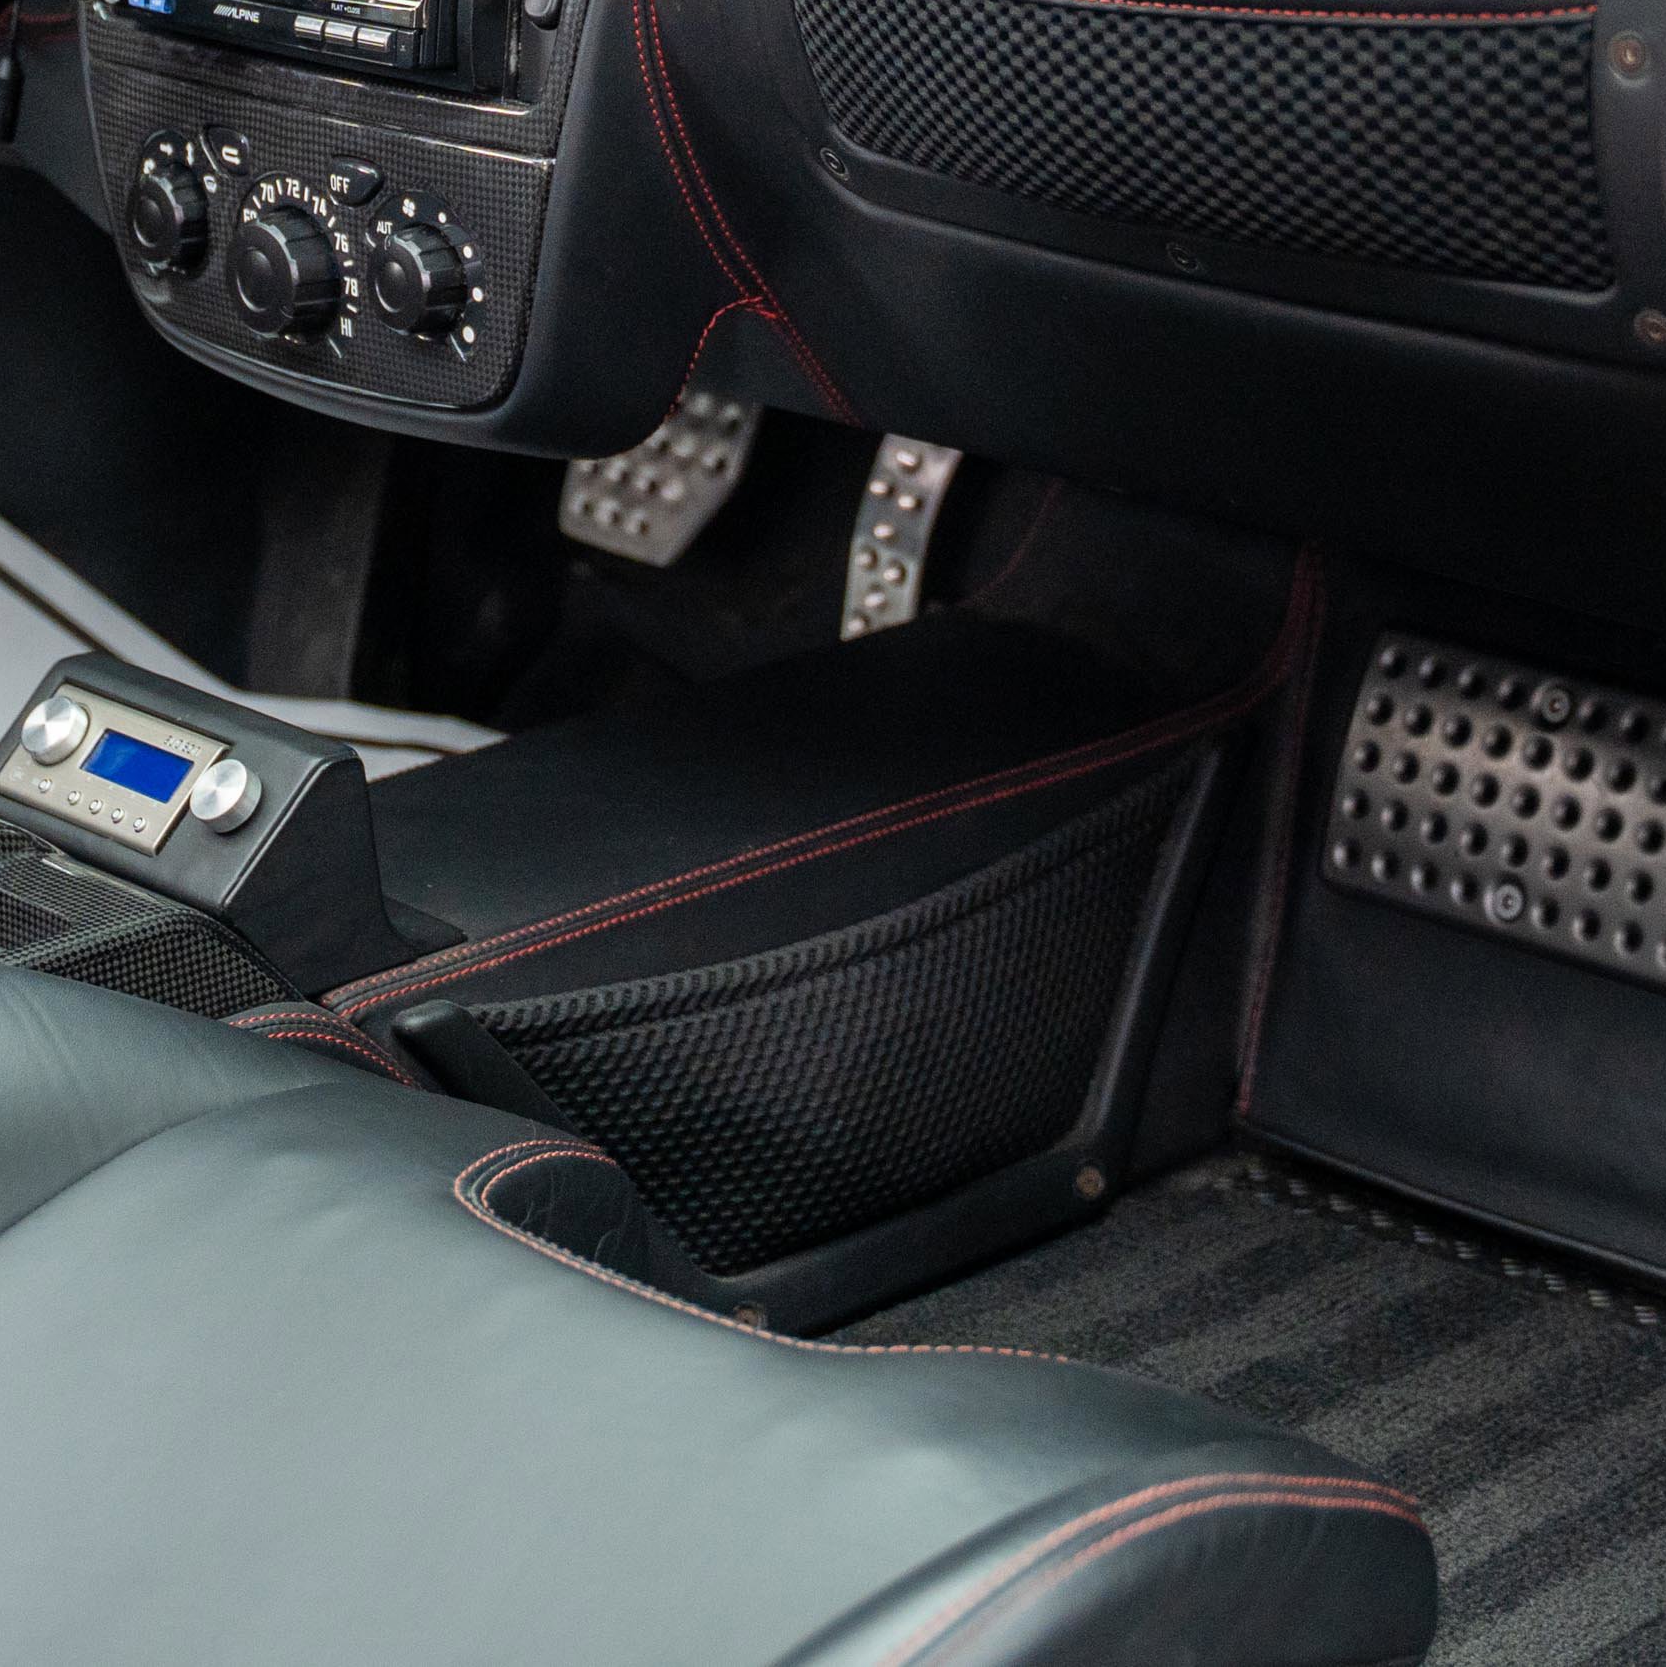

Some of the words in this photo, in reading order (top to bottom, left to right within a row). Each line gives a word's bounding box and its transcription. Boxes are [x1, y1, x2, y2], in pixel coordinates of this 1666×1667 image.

[227, 5, 261, 24] ALPINE
[260, 182, 275, 203] 70
[286, 178, 301, 199] 72
[329, 174, 350, 194] OFF
[312, 195, 327, 217] 74
[334, 231, 349, 254] 76
[343, 276, 359, 298] 78
[340, 317, 352, 338] HI
